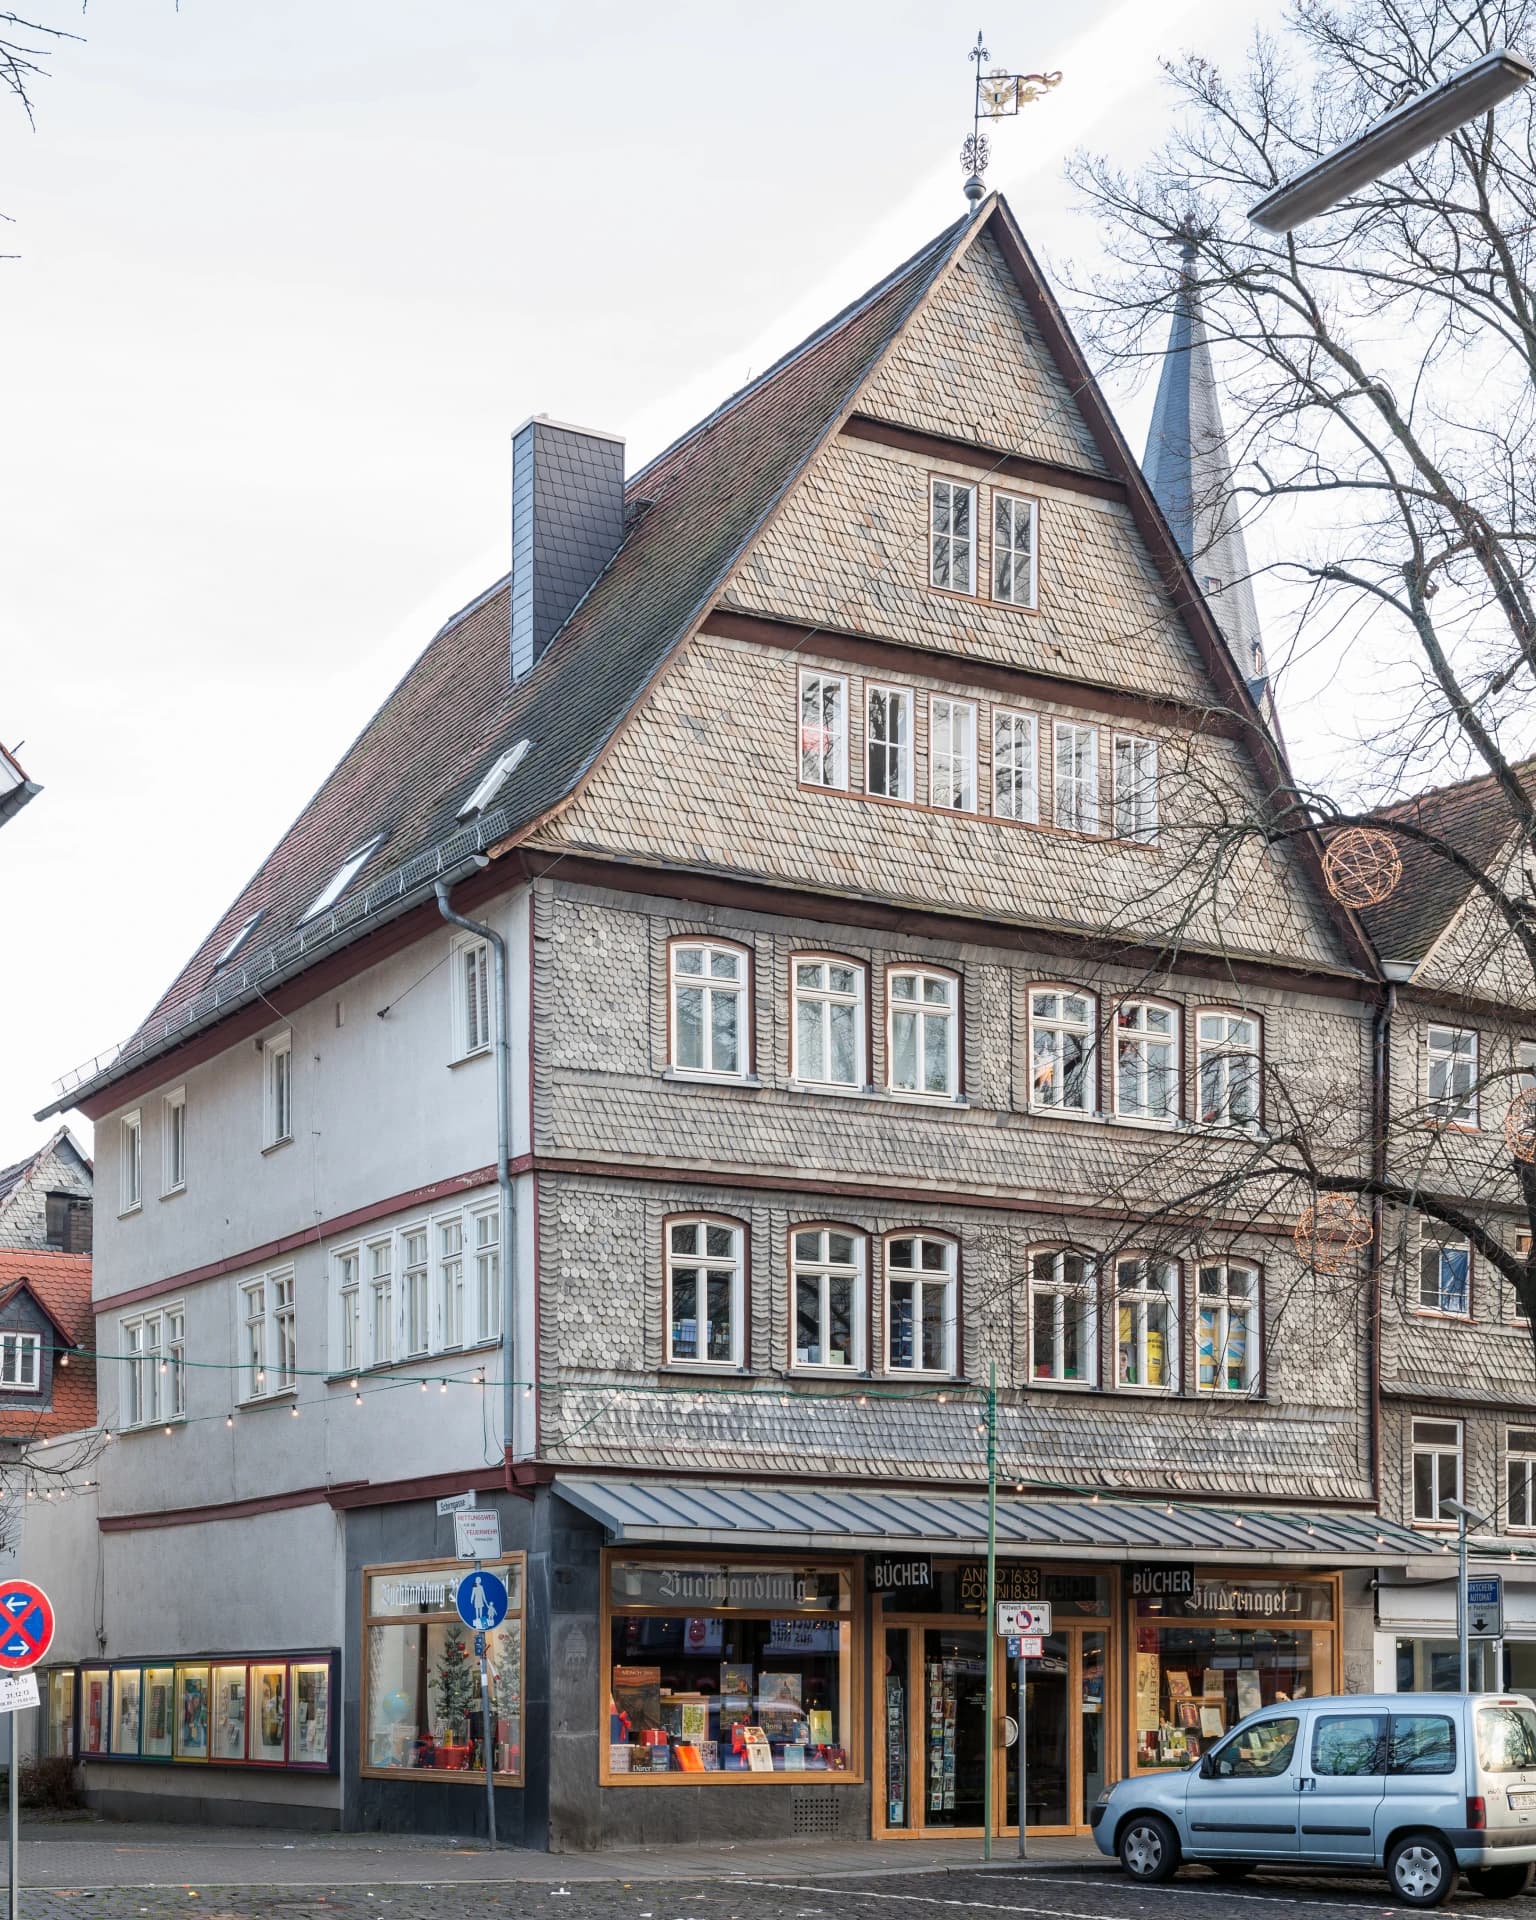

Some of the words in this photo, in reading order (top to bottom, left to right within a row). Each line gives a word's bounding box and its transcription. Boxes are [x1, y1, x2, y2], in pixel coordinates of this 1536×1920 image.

[875, 1560, 929, 1587] BÜCHER
[1010, 1570, 1039, 1584] 1633
[1132, 1568, 1191, 1594] BÜCHER
[658, 1571, 807, 1604] Buchhandlung
[961, 1583, 1009, 1599] DOINI
[1010, 1585, 1039, 1599] 1834
